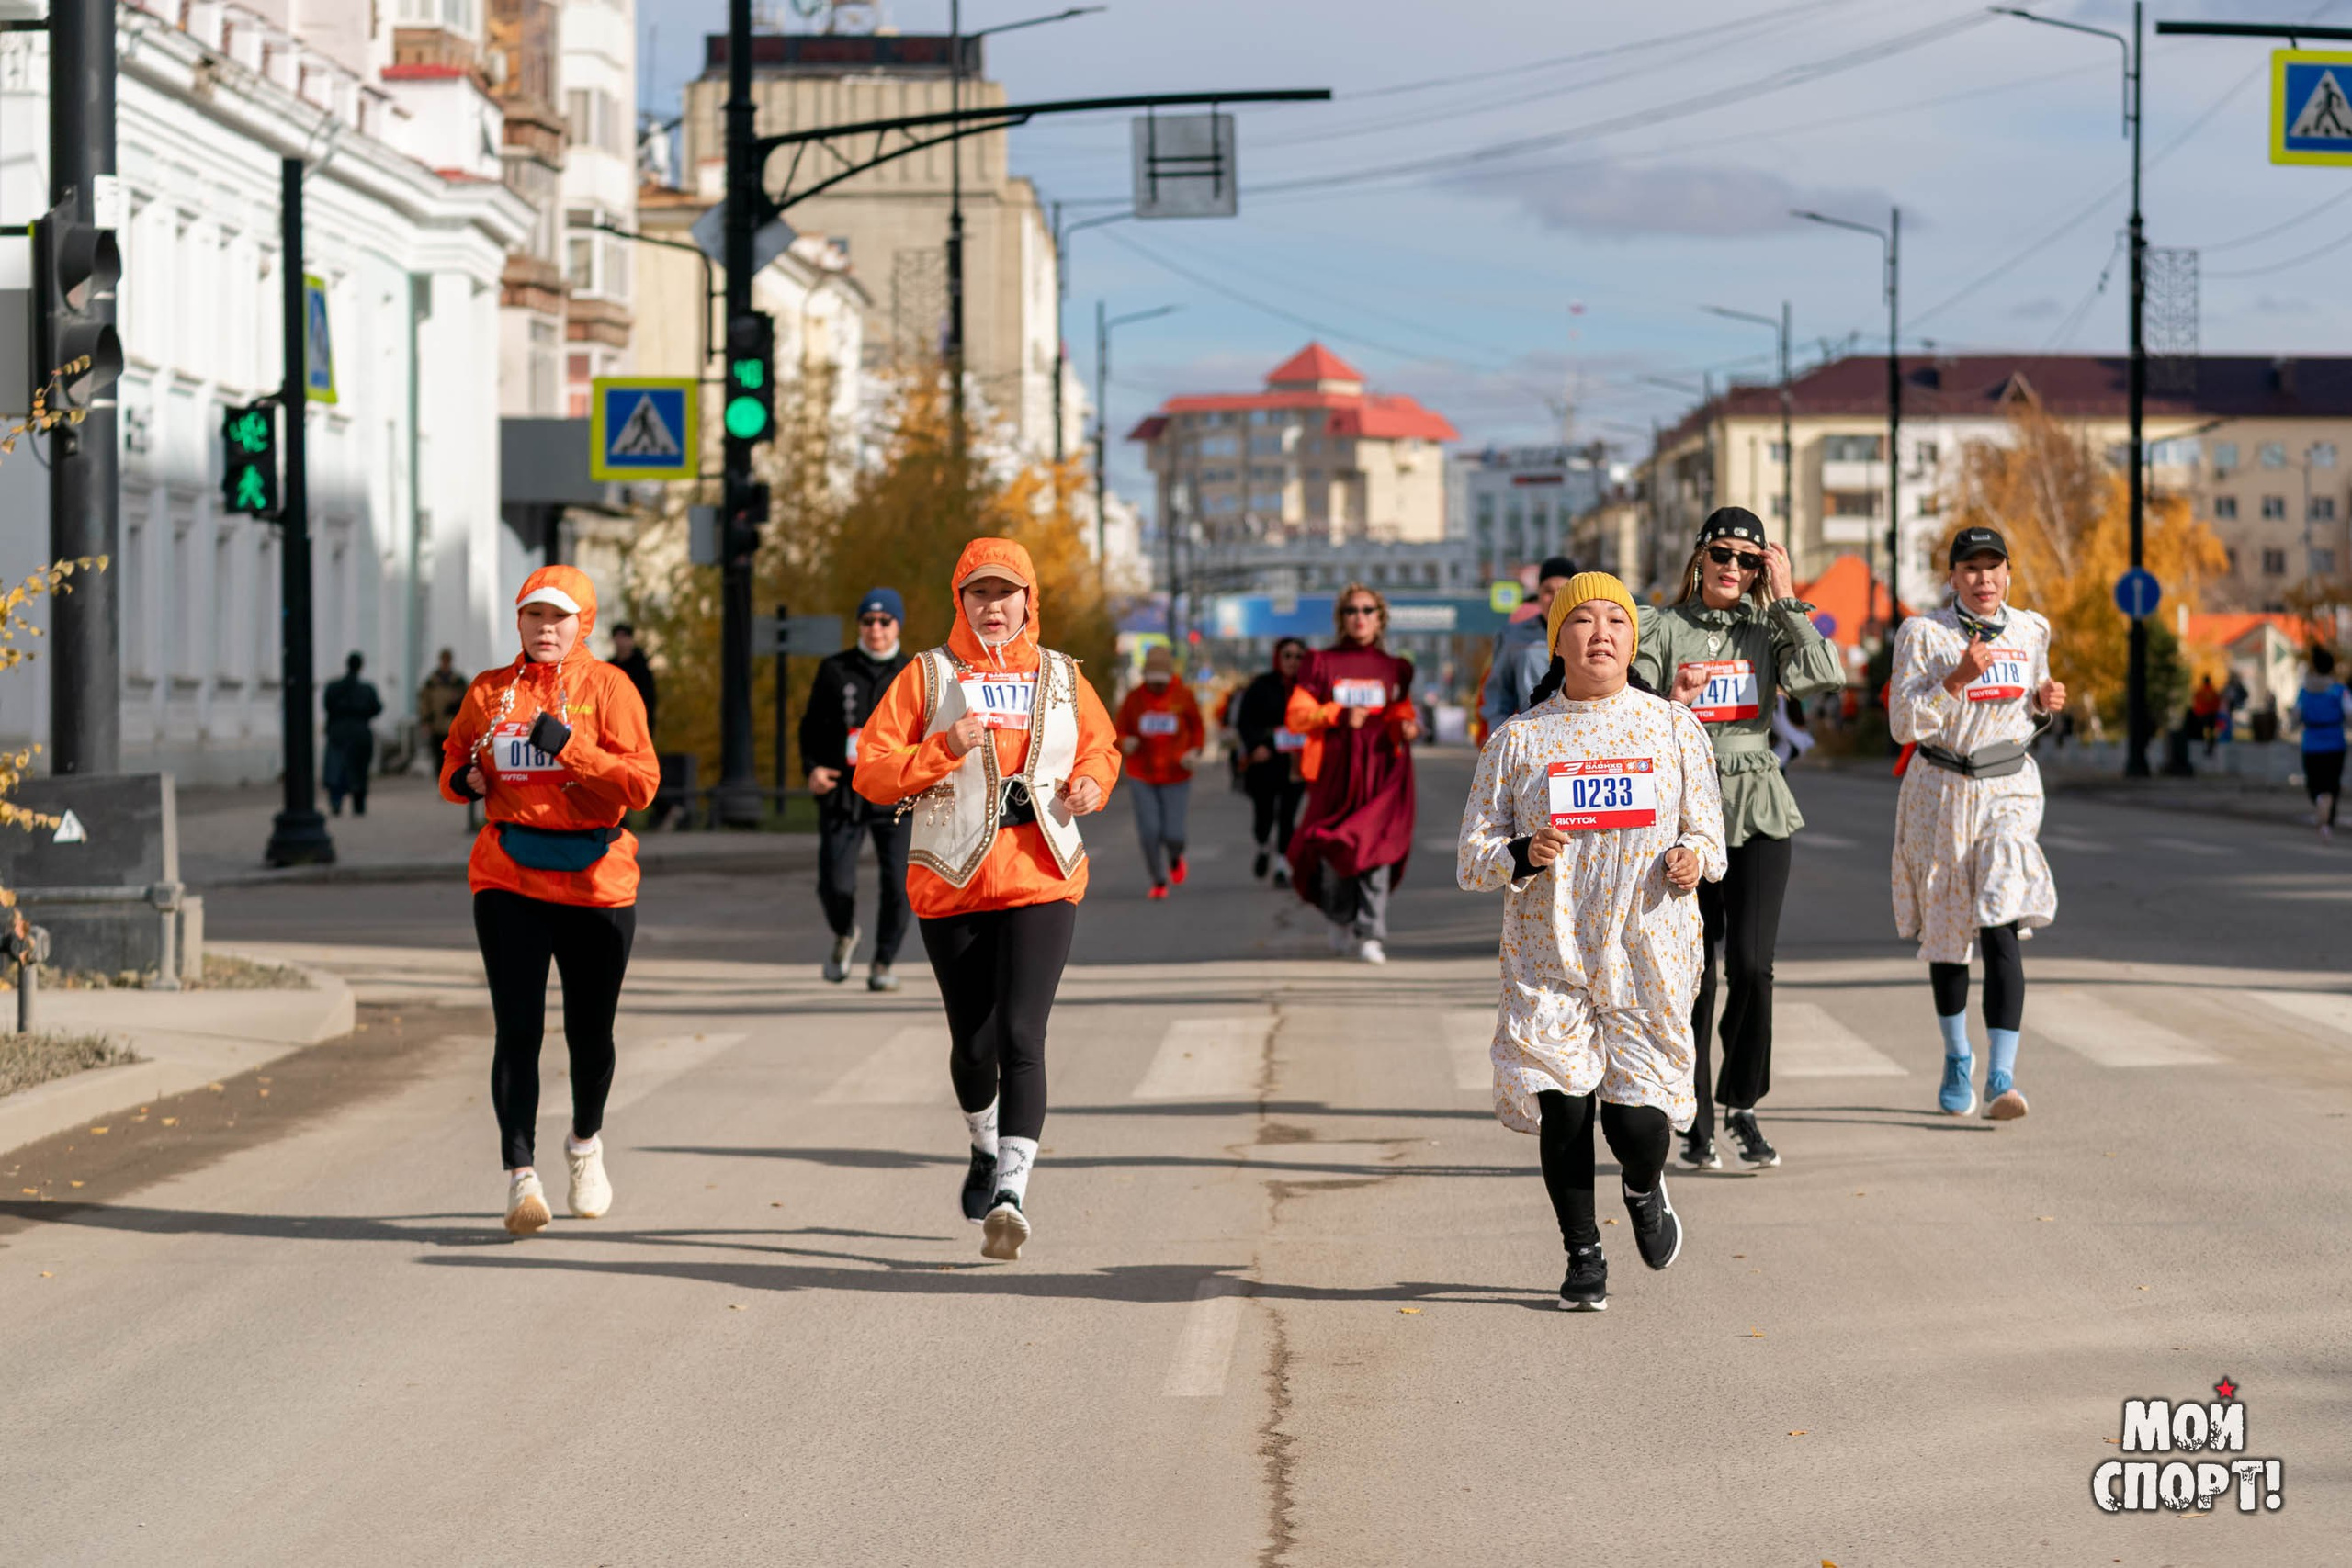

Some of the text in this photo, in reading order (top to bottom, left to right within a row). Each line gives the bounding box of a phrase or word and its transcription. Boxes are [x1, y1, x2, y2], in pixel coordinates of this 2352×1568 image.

[982, 684, 1029, 711] 0177
[1572, 777, 1633, 808] 0233
[1555, 816, 1597, 826] ЯКУТСК
